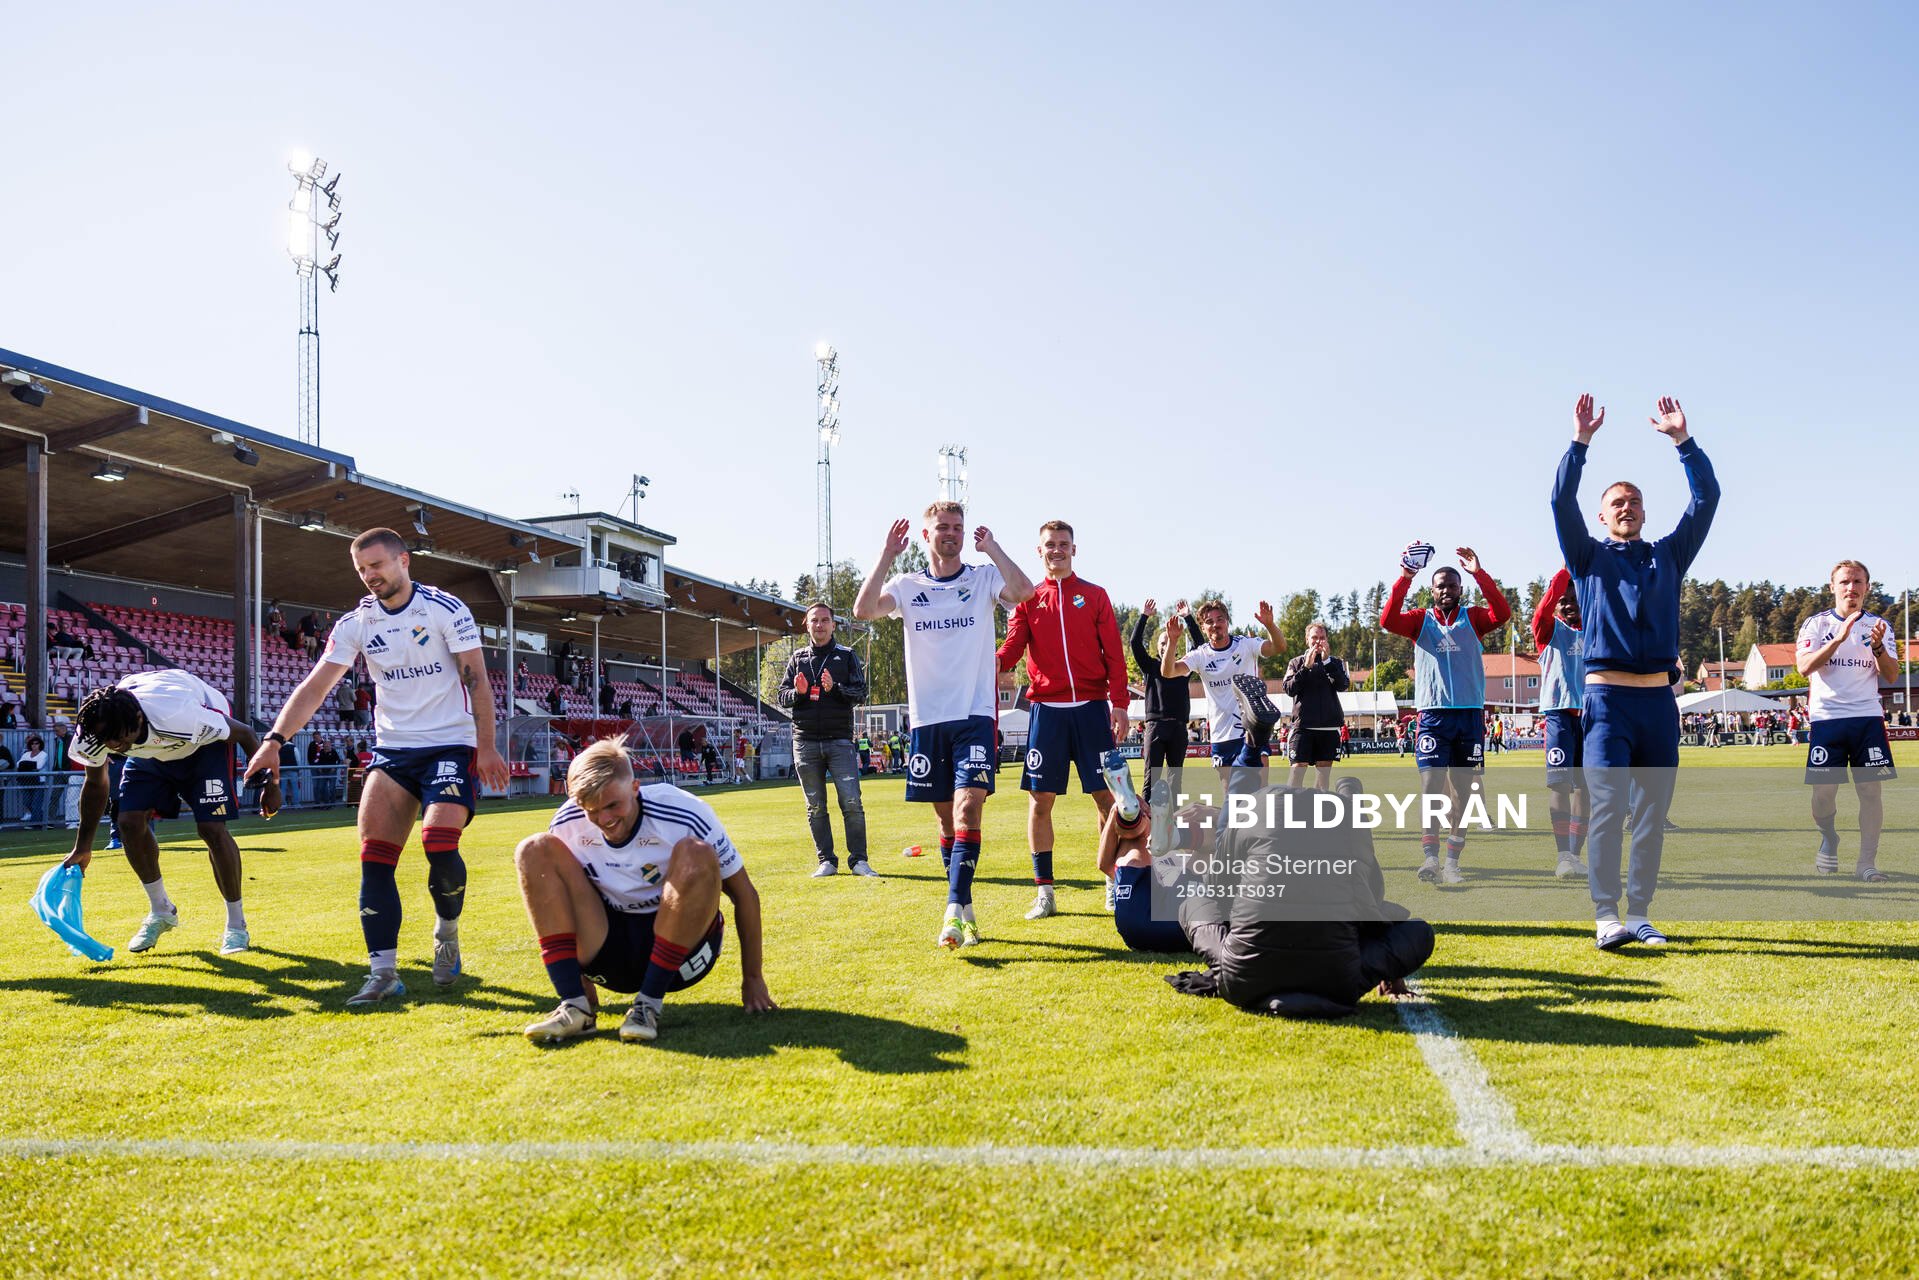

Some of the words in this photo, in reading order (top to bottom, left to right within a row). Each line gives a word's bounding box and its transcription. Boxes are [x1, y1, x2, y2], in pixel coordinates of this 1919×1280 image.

[915, 616, 975, 632] EMILSHUS
[367, 647, 389, 655] stadium
[1209, 678, 1232, 688] EMILS
[1361, 741, 1407, 749] PALMQVT
[1865, 759, 1890, 767] BALCO
[200, 795, 228, 803] BALCO
